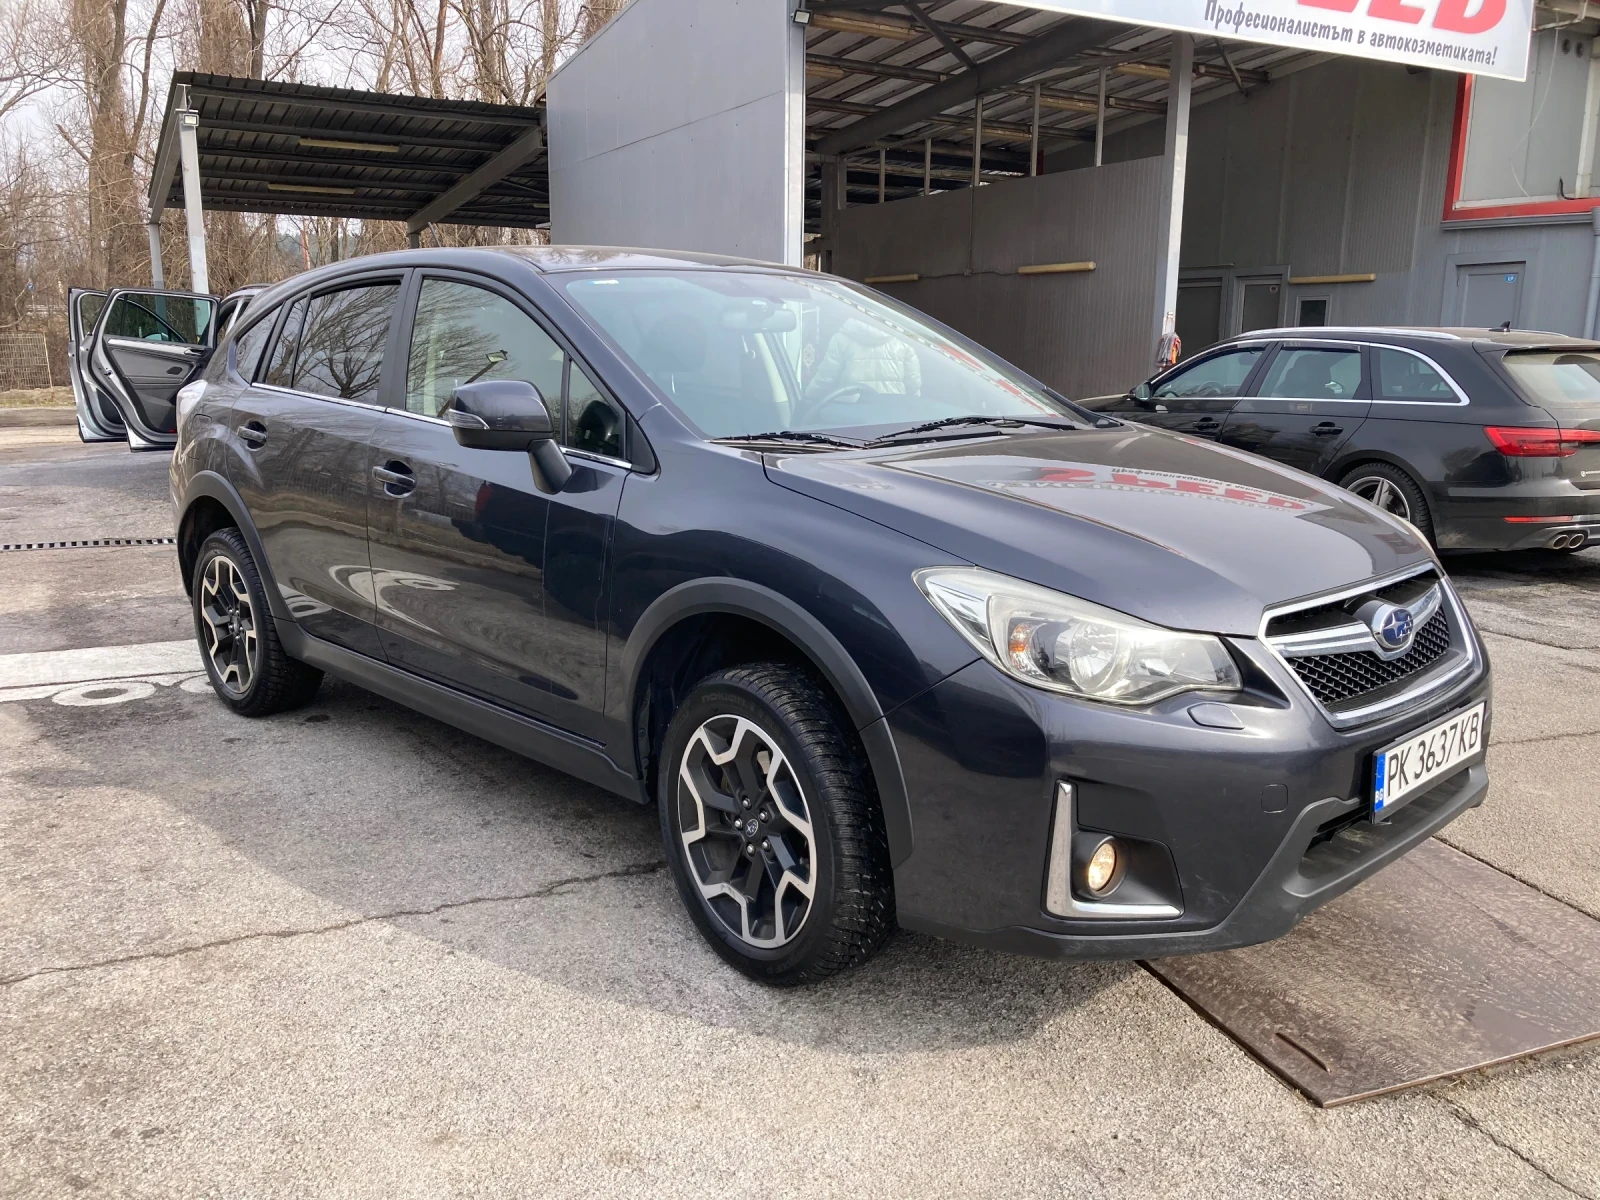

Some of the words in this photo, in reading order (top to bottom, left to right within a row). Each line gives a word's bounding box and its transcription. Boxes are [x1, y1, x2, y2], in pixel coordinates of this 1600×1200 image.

[1204, 0, 1354, 43] Професионалистът
[1356, 29, 1366, 45] в
[1369, 31, 1498, 66] автокозметиката!
[1387, 745, 1412, 798] PK
[1414, 721, 1459, 780] 3637
[1458, 711, 1480, 756] KB
